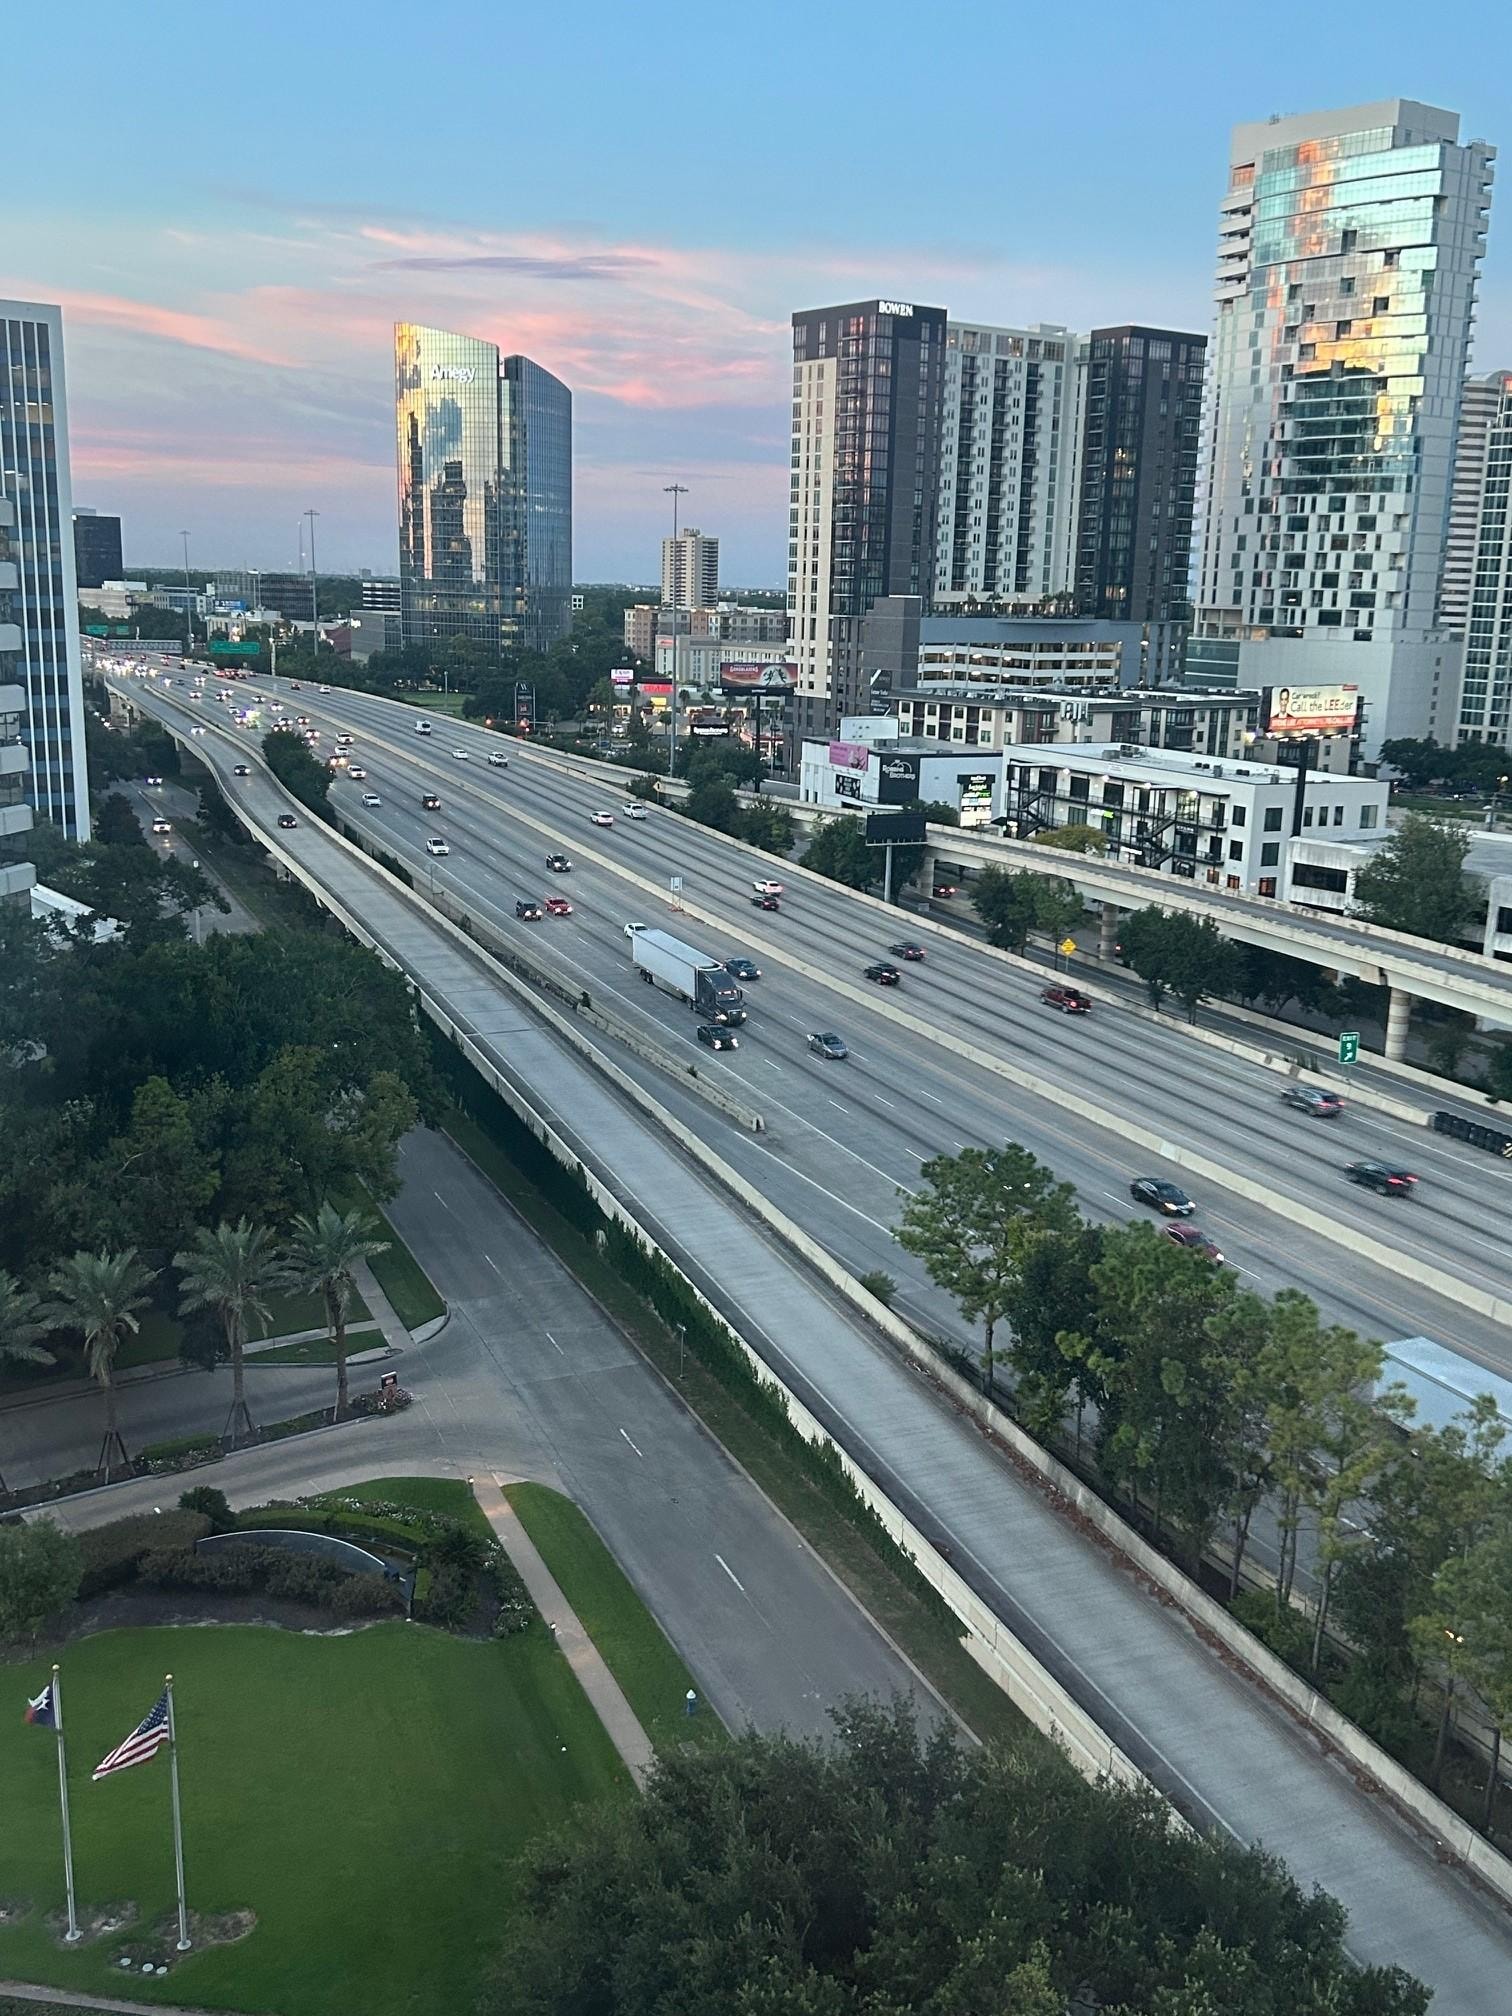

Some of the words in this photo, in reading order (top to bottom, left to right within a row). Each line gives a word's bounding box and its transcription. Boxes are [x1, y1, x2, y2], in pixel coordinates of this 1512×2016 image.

[878, 300, 914, 317] BOWEN
[431, 363, 476, 384] Amegy
[1290, 700, 1307, 713] Call
[1309, 699, 1323, 711] the
[1342, 1034, 1357, 1042] EXIT
[1346, 1042, 1353, 1051] 9
